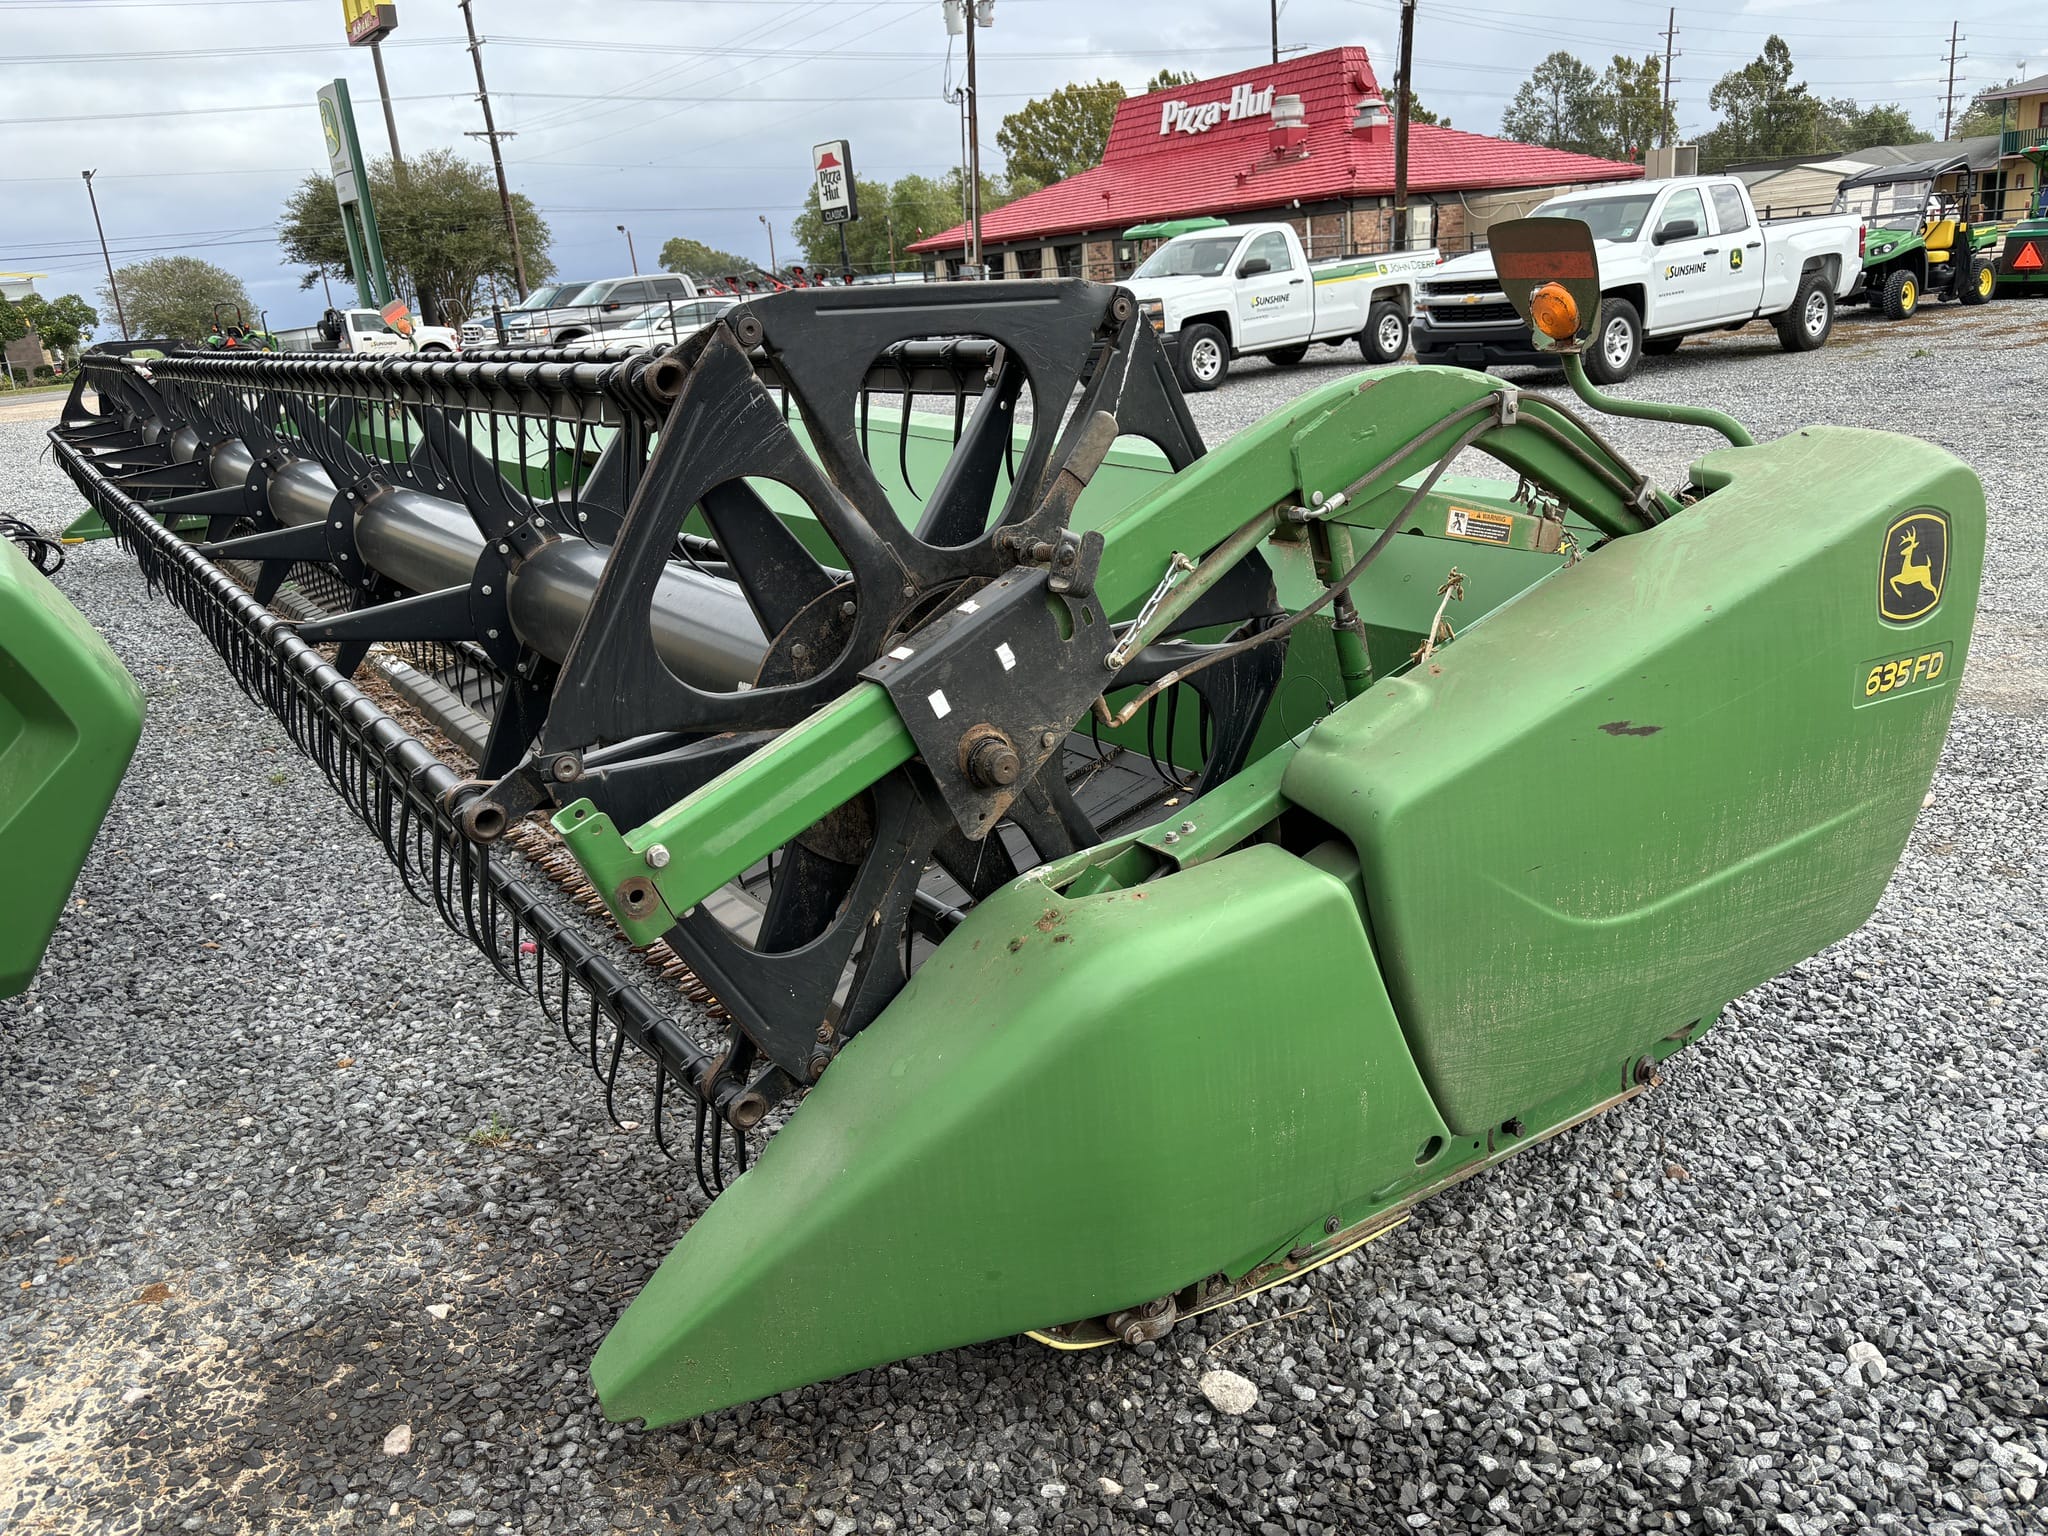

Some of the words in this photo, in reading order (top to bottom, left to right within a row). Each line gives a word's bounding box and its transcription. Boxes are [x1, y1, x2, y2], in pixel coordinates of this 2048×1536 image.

[1160, 100, 1222, 135] Pizza
[1222, 83, 1276, 121] Hut
[819, 169, 841, 187] Pizza
[823, 185, 840, 201] Hut
[825, 209, 845, 221] CLASSIC
[1390, 262, 1411, 273] JOHN
[1411, 260, 1435, 270] DEERE
[1669, 262, 1707, 278] SUNSHINE
[1255, 293, 1290, 307] SUNSHINE
[1482, 512, 1506, 523] WARNING
